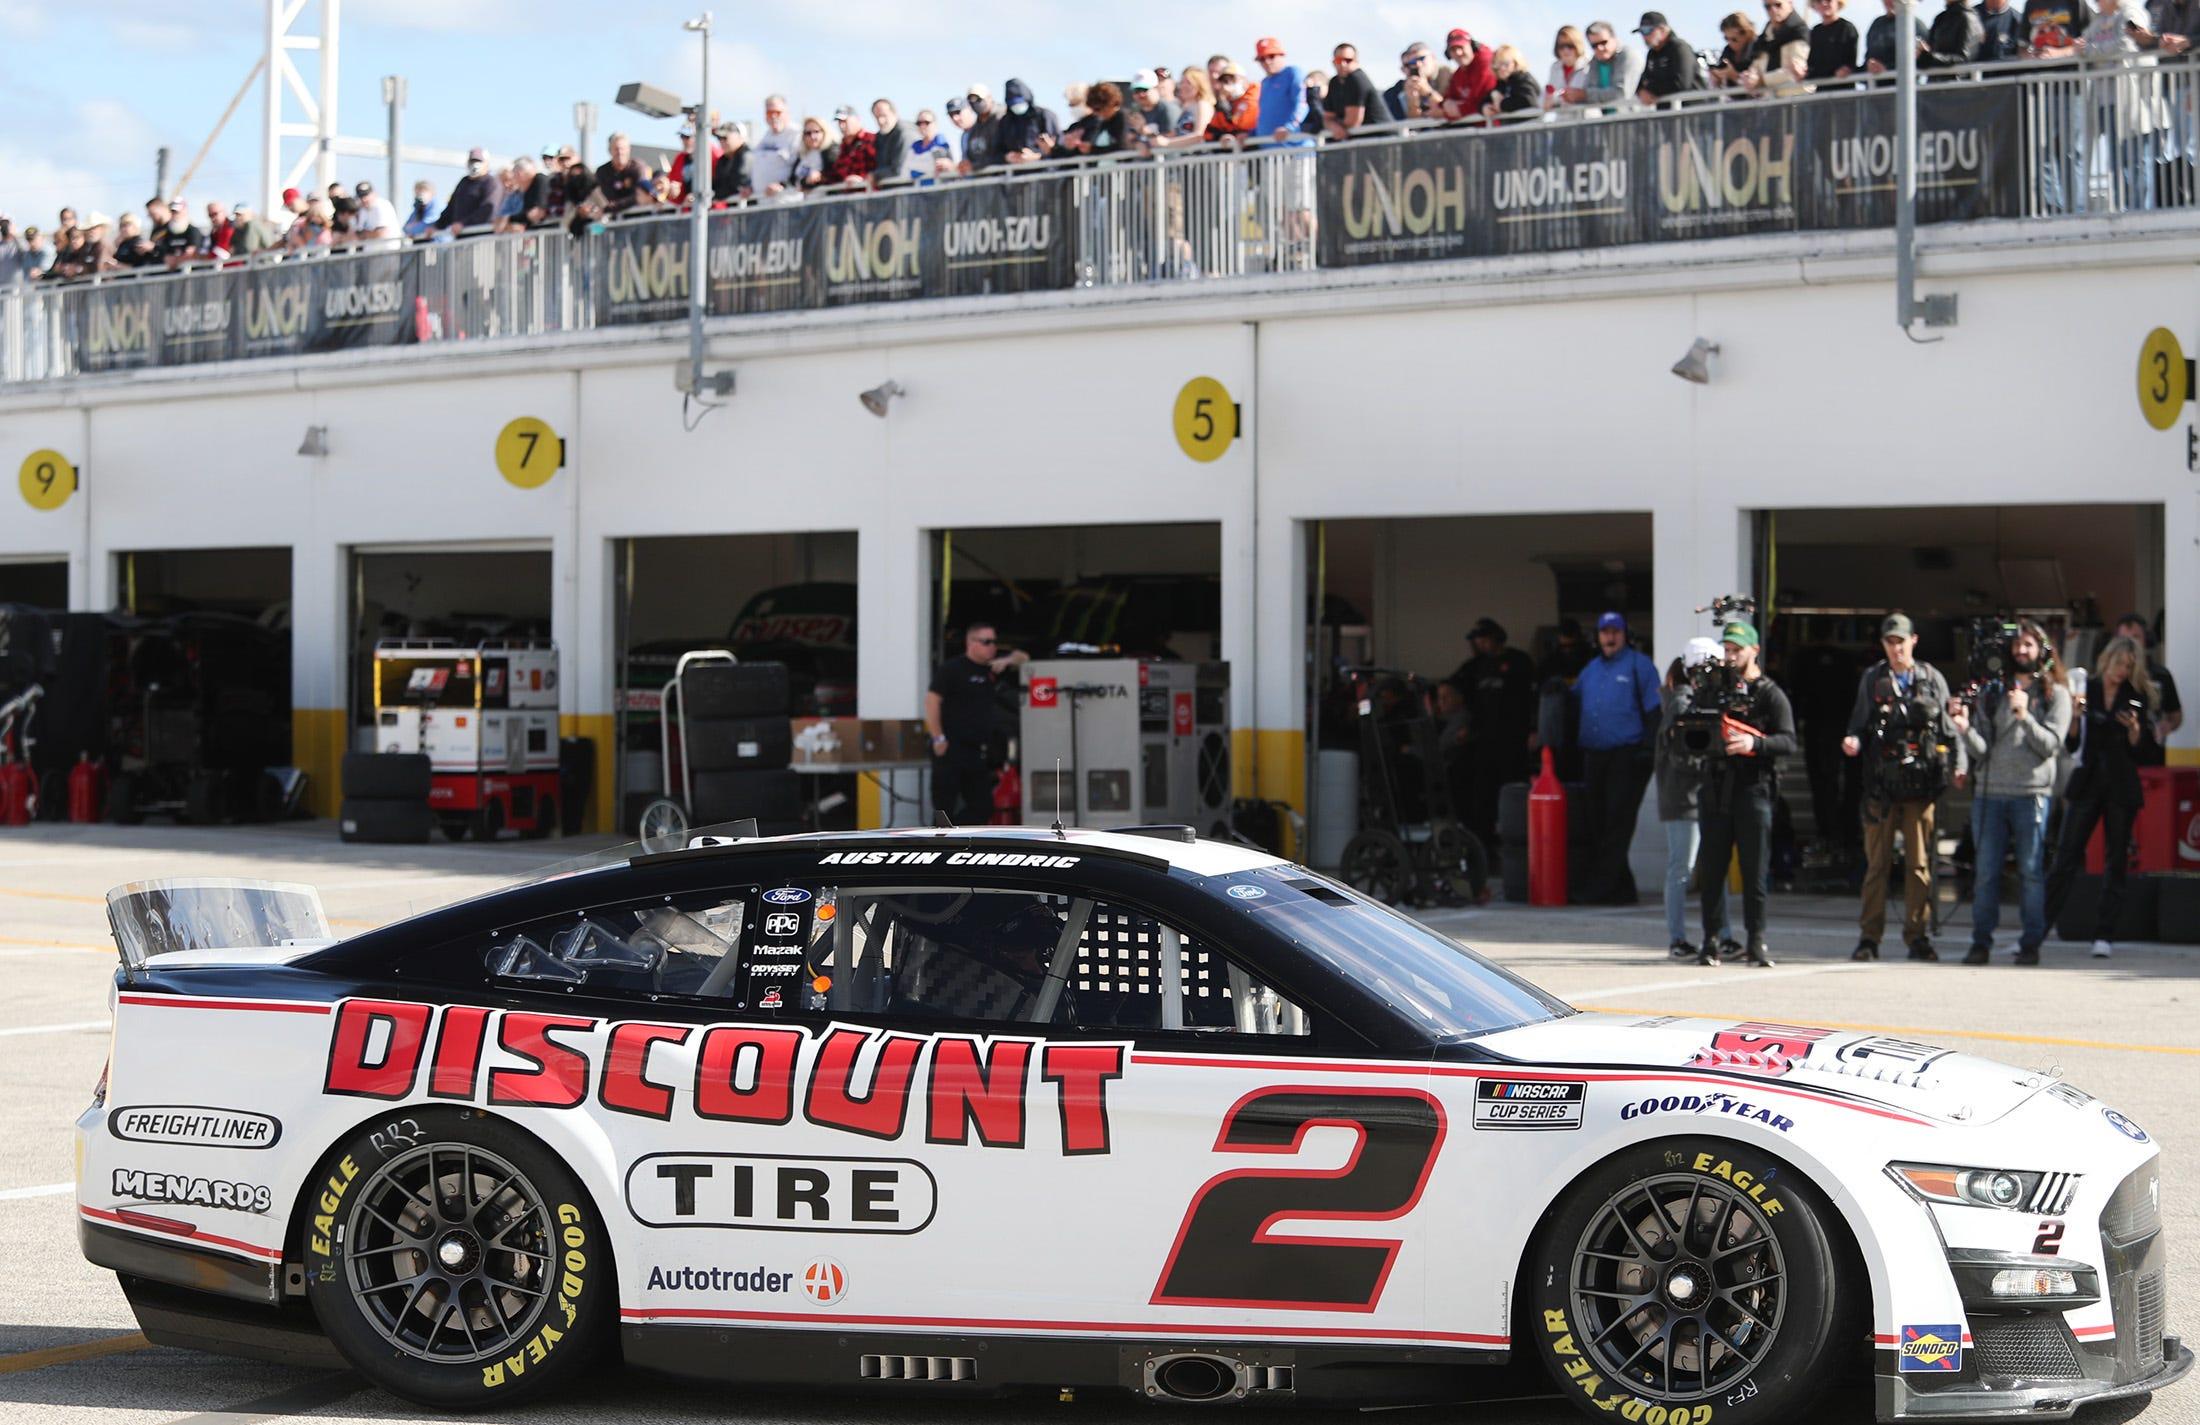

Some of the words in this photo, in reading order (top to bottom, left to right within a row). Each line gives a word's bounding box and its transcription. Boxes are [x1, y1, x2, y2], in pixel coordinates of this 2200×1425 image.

[1493, 160, 1627, 209] UNOH.EDU
[1658, 127, 1794, 213] UNOH
[1342, 160, 1465, 239] UNOH
[709, 238, 803, 280] UNOH.EDU
[826, 209, 921, 283] UNOH
[608, 234, 689, 303] UNOH
[2151, 351, 2169, 404] 3
[1193, 398, 1214, 442] 5
[517, 431, 539, 469] 7
[35, 461, 55, 495] 9
[818, 852, 942, 865] AUSTIN
[946, 852, 1080, 868] CINDRIC
[768, 916, 797, 933] PPG
[751, 964, 800, 973] ODYSSEY
[753, 945, 802, 955] Mazak
[323, 998, 1124, 1156] DISCOUNT
[1510, 1084, 1569, 1098] NASCAR
[125, 1114, 268, 1141] FREIGHTLINER
[1490, 1104, 1518, 1118] CUP
[1519, 1104, 1567, 1118] SERIES
[112, 1168, 272, 1214] MENARDS
[311, 1154, 360, 1257] EAGLE
[657, 1164, 899, 1223] TIRE
[1148, 1084, 1448, 1314] 2
[1693, 1152, 1784, 1217] EAGLE
[2031, 1220, 2065, 1256] 2
[647, 1266, 793, 1293] Autotrader
[1903, 1342, 1957, 1355] SUNOCO
